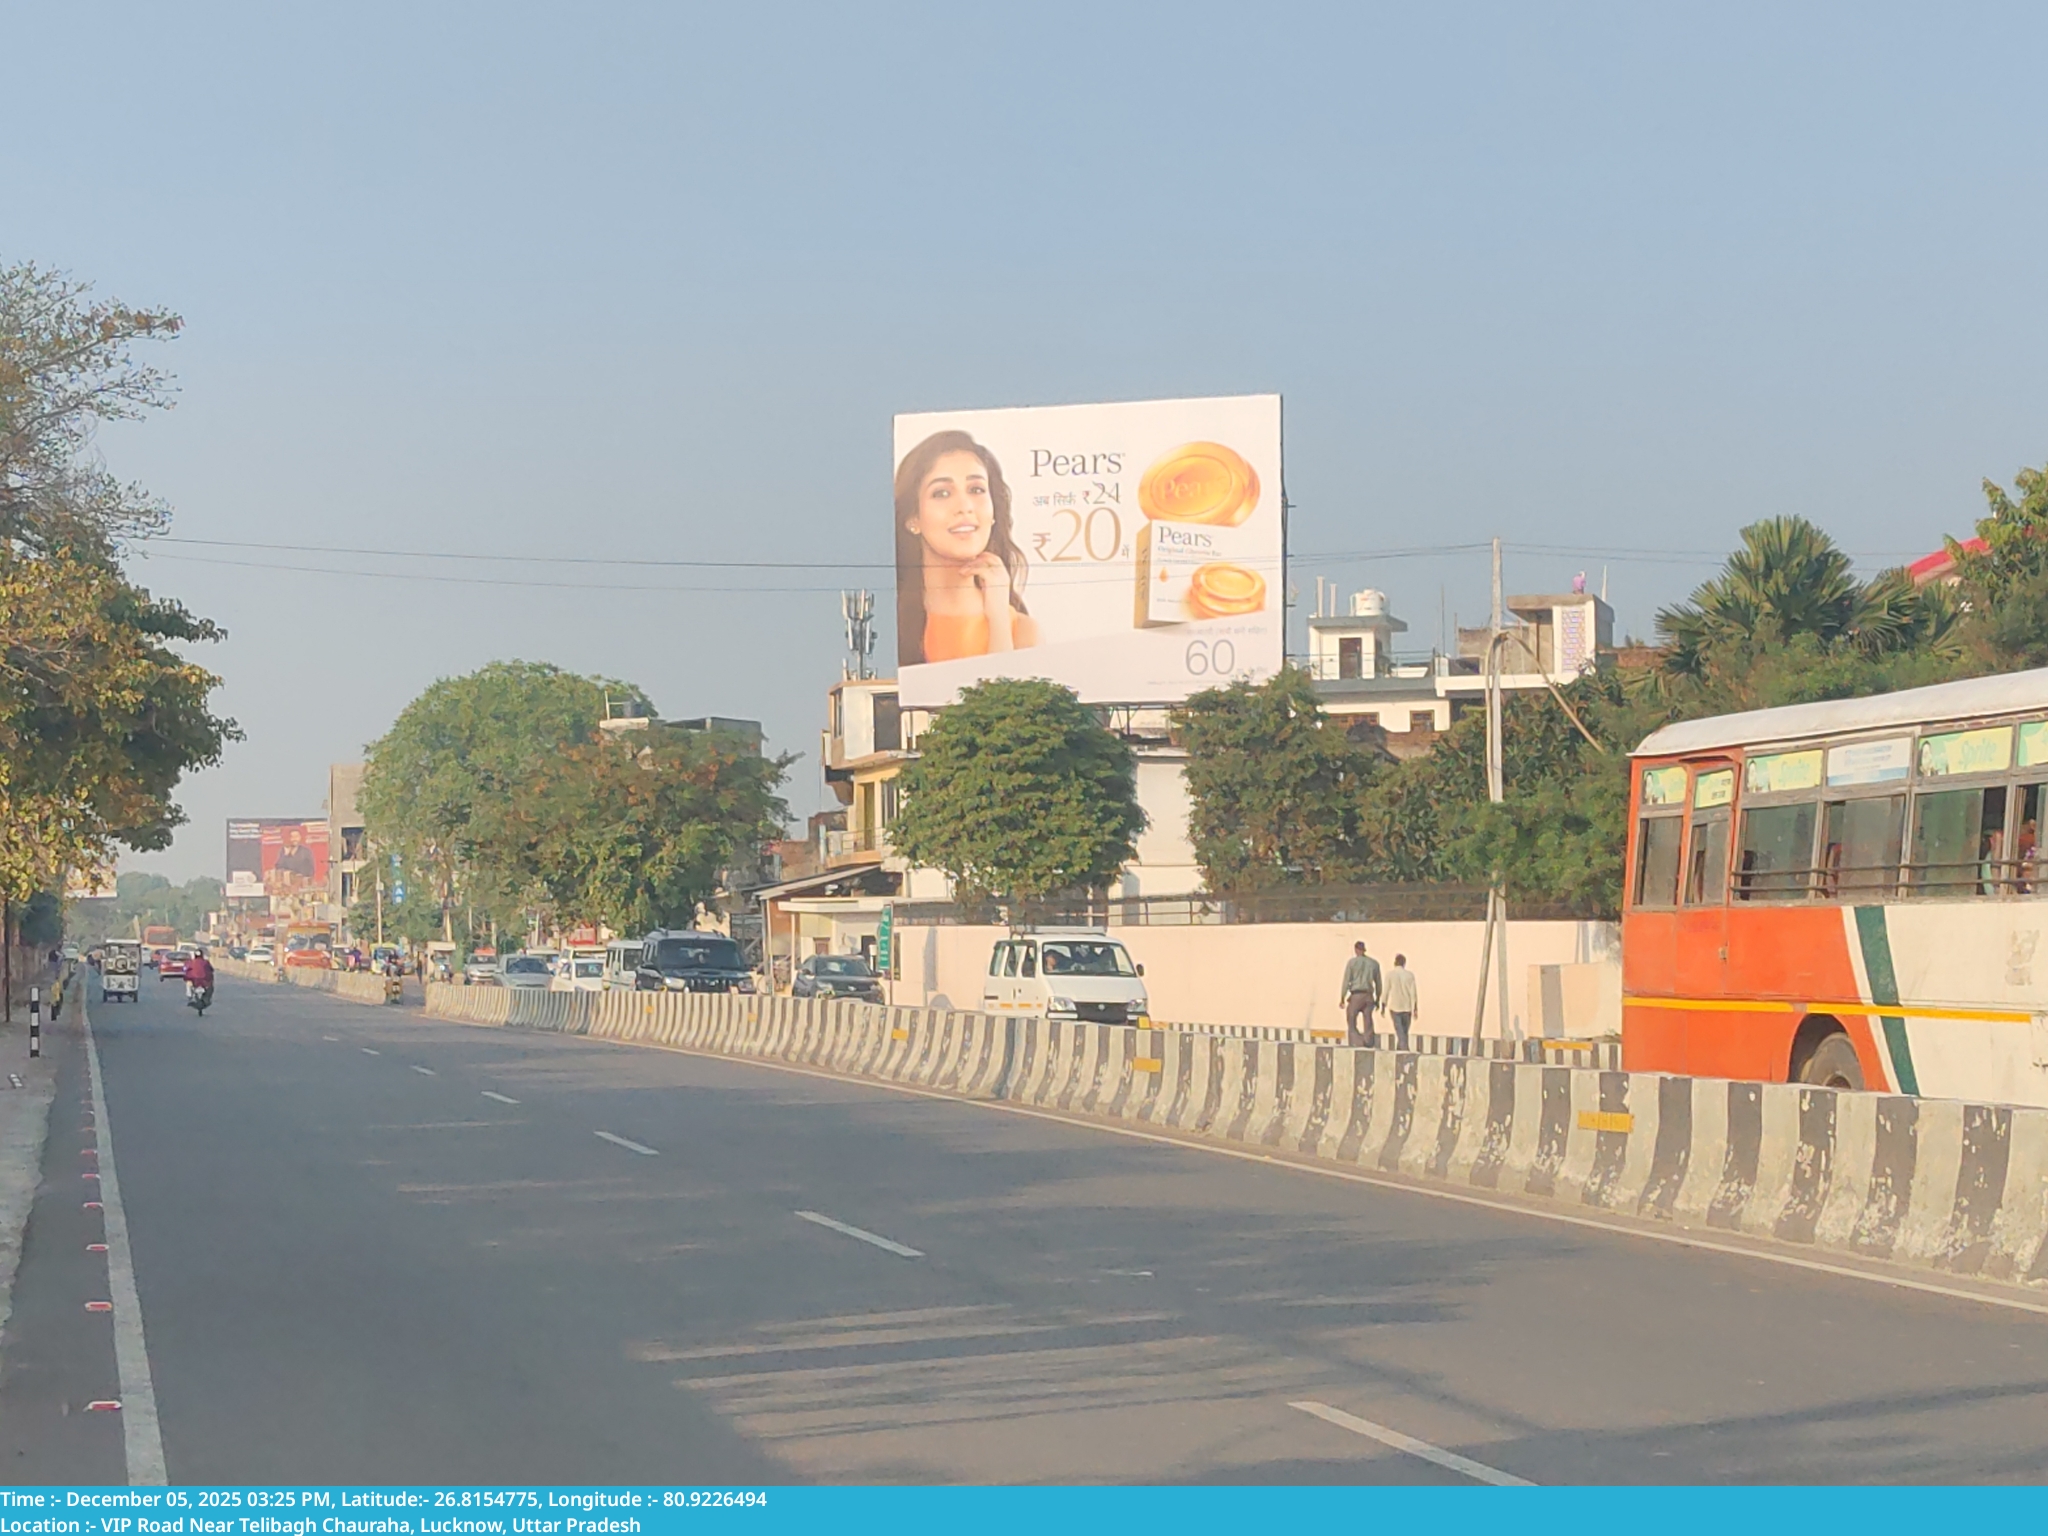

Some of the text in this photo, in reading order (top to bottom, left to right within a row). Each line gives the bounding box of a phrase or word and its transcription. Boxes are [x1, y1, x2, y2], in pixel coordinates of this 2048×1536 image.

[1030, 449, 1122, 477] Pears
[1032, 495, 1050, 507] अब
[1032, 507, 1122, 562] ₹20
[1158, 525, 1213, 548] Pears
[1185, 639, 1236, 676] 60
